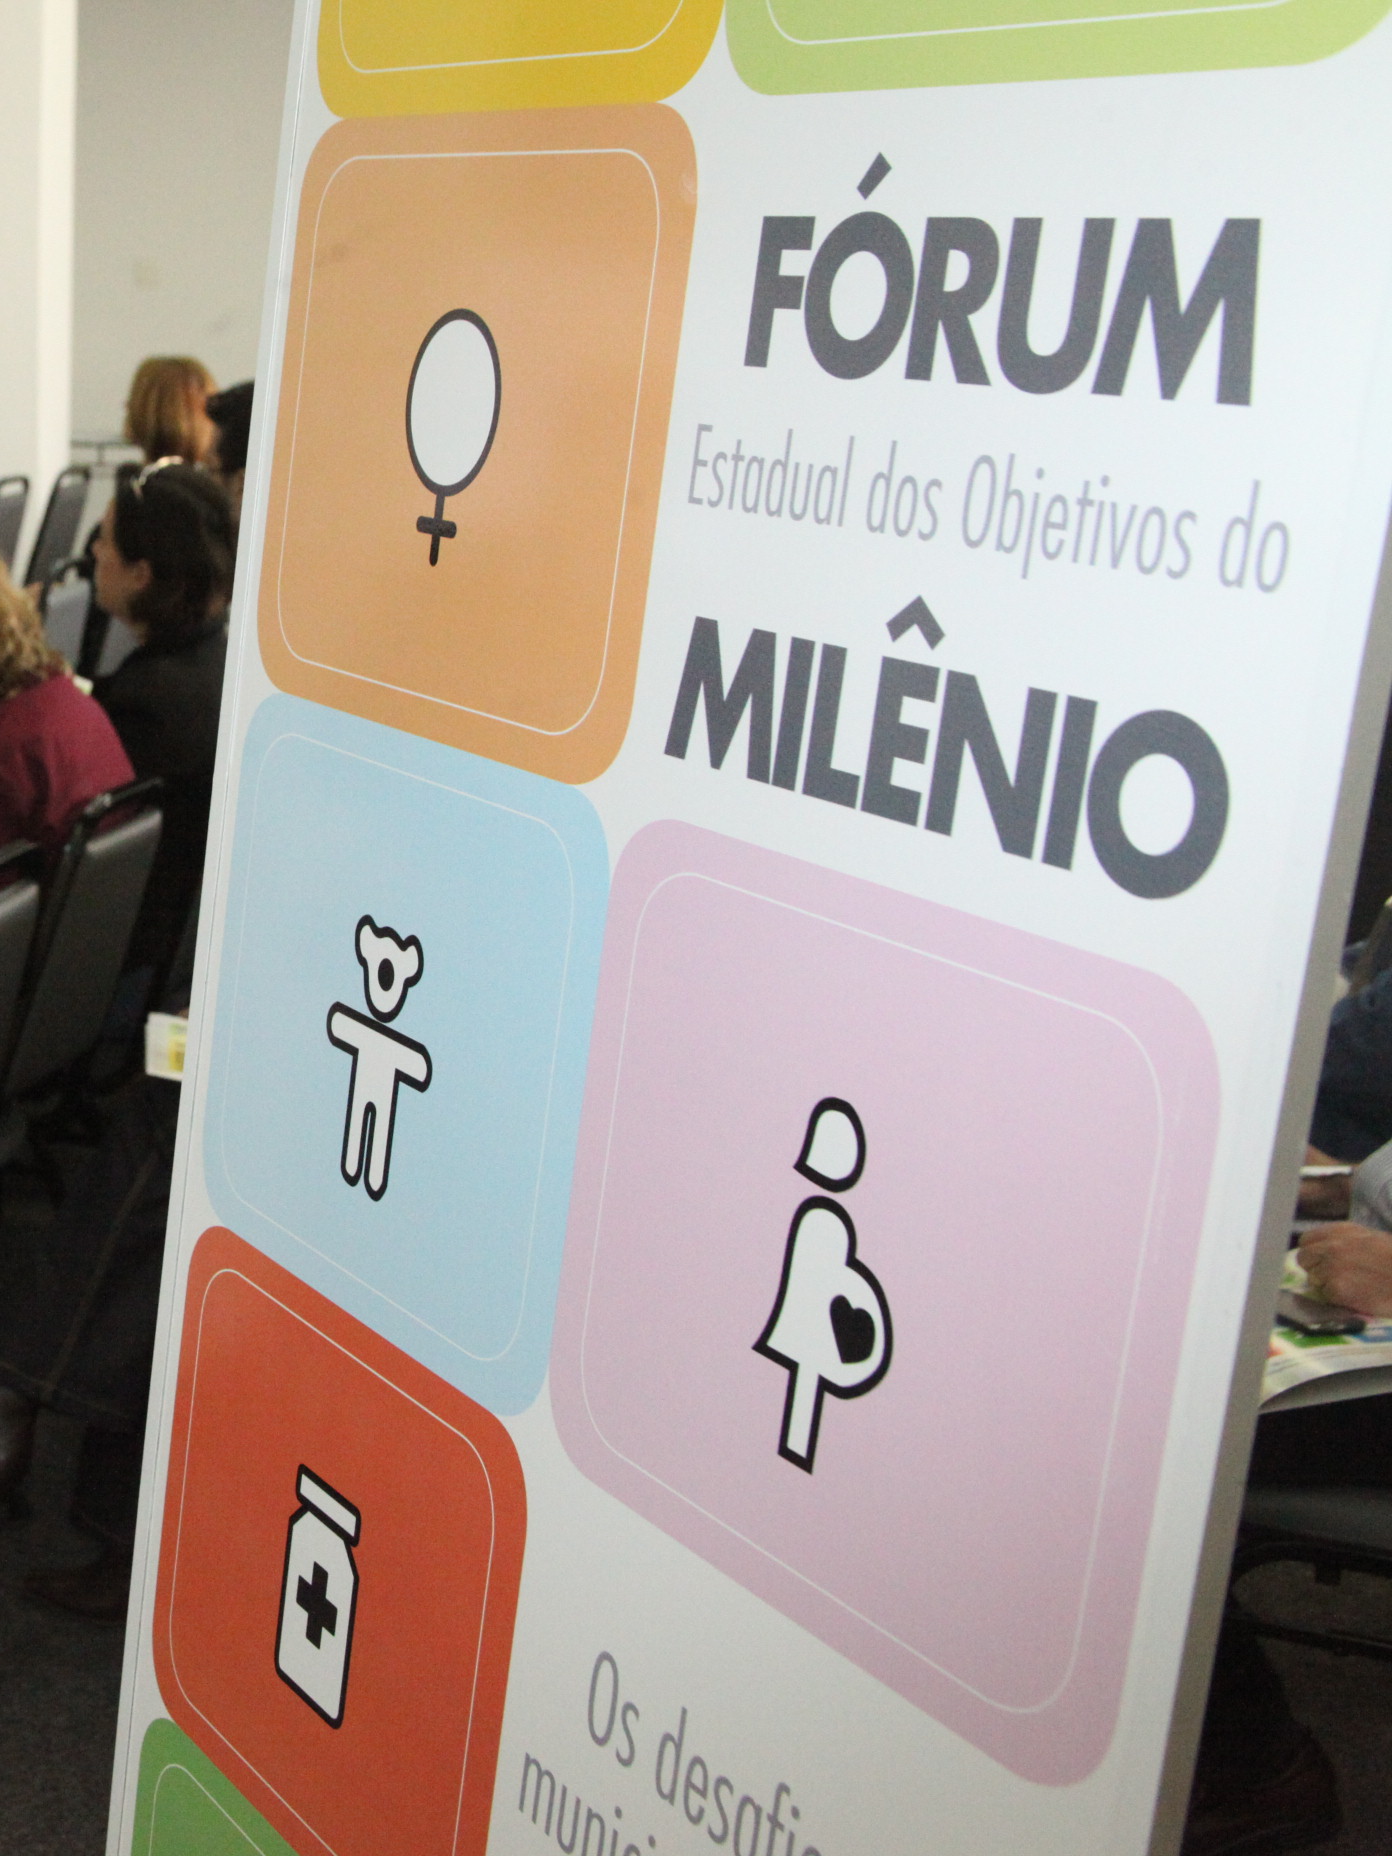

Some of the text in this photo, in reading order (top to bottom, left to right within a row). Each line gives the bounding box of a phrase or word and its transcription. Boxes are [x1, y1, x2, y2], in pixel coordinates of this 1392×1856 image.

[743, 151, 1261, 407] FÓRUM
[687, 422, 1290, 593] Estadual dos Objetivos do
[663, 594, 1231, 900] MILÊNIO
[587, 1650, 823, 1856] Os desafi
